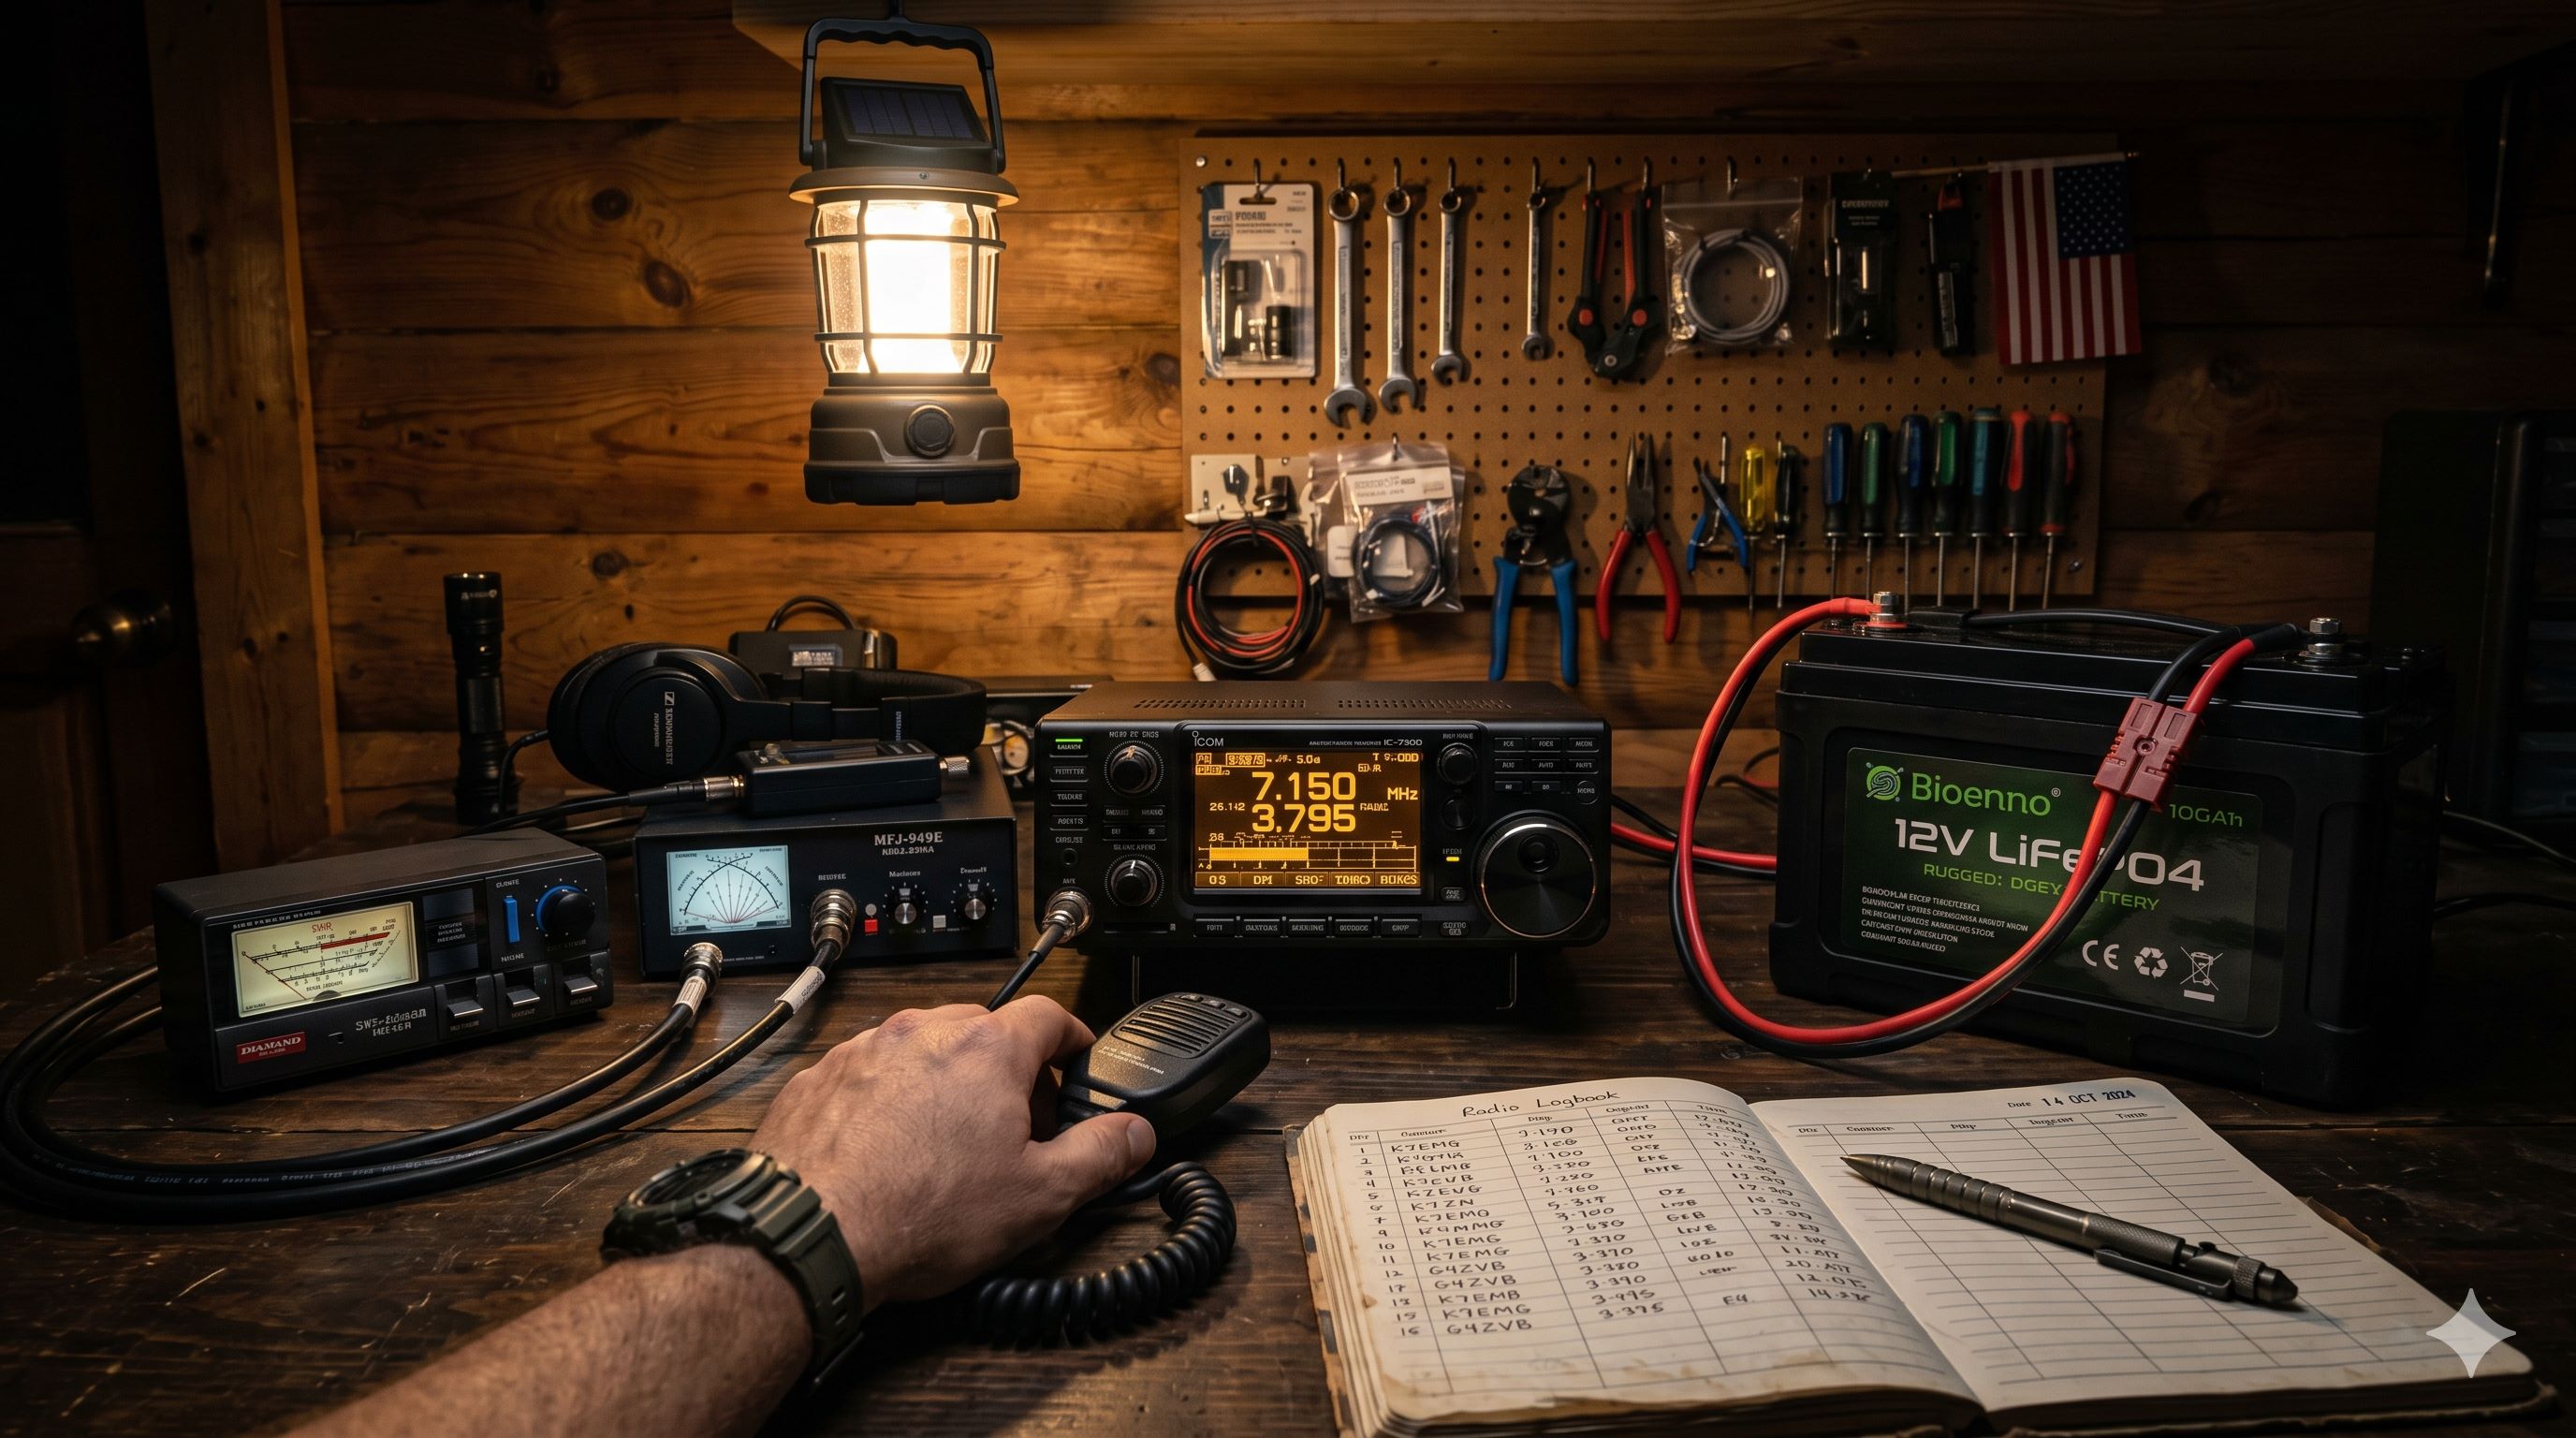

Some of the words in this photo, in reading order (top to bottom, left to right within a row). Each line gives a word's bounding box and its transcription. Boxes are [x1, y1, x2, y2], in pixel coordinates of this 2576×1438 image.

[1252, 772, 1355, 800] 7.150
[1387, 787, 1418, 800] MHz
[1911, 772, 2050, 815] Bioenno
[1251, 804, 1355, 832] 3.795
[874, 831, 944, 846] MFJ-949E
[1894, 817, 1974, 857] 12V
[1924, 863, 2003, 887] RUGGED:
[1462, 1104, 1519, 1118] Radio
[1536, 1091, 1620, 1108] Logbook
[2069, 1093, 2097, 1104] OCT
[2101, 1090, 2136, 1100] 2024
[1429, 1261, 1505, 1274] G4ZVB
[1435, 1274, 1515, 1289] G4ZVB
[1447, 1319, 1531, 1334] G4ZVB
